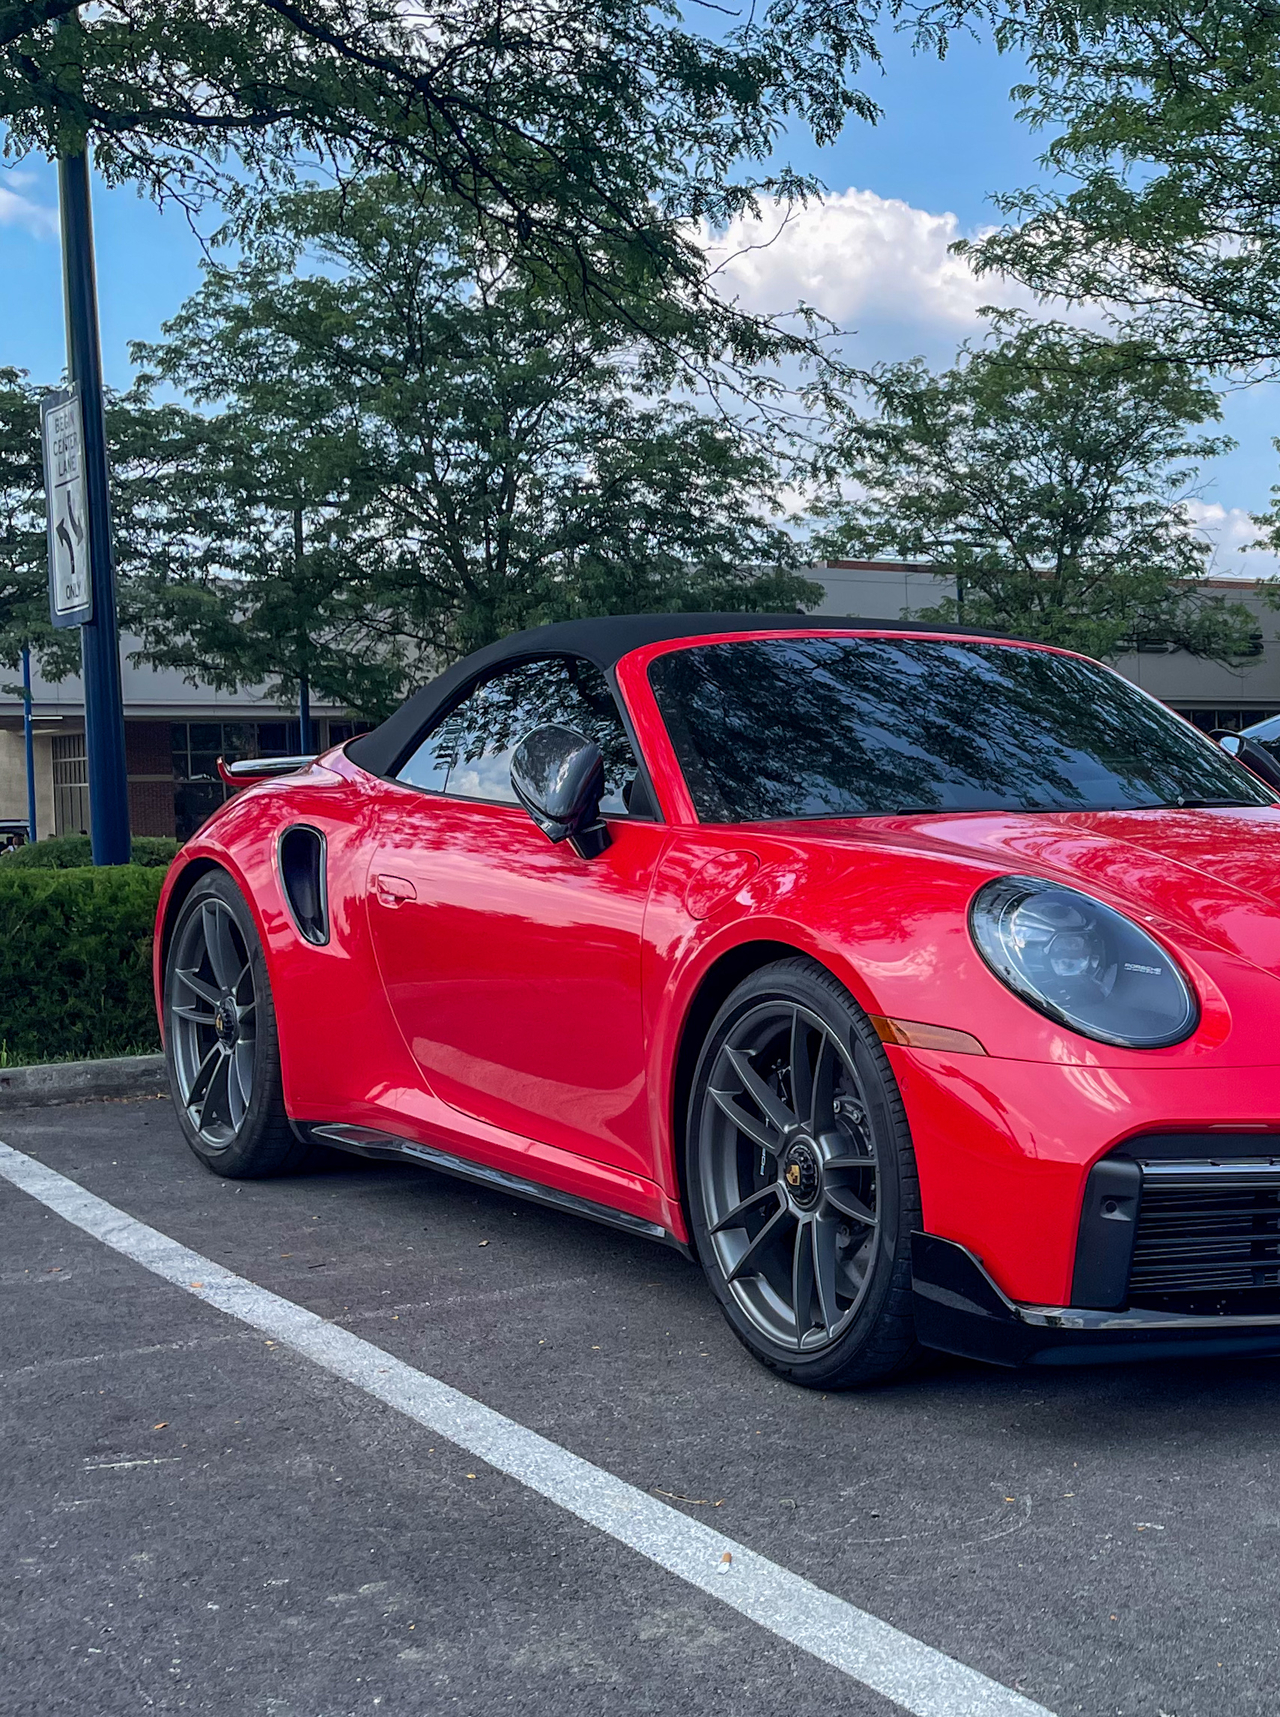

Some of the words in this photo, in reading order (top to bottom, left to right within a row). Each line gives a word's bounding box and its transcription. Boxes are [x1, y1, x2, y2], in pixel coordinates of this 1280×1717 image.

[55, 411, 75, 434] BEGIN
[53, 432, 78, 456] CENTER
[58, 455, 77, 477] LANE
[65, 580, 82, 600] ONLY
[1124, 963, 1162, 972] PORSCHE
